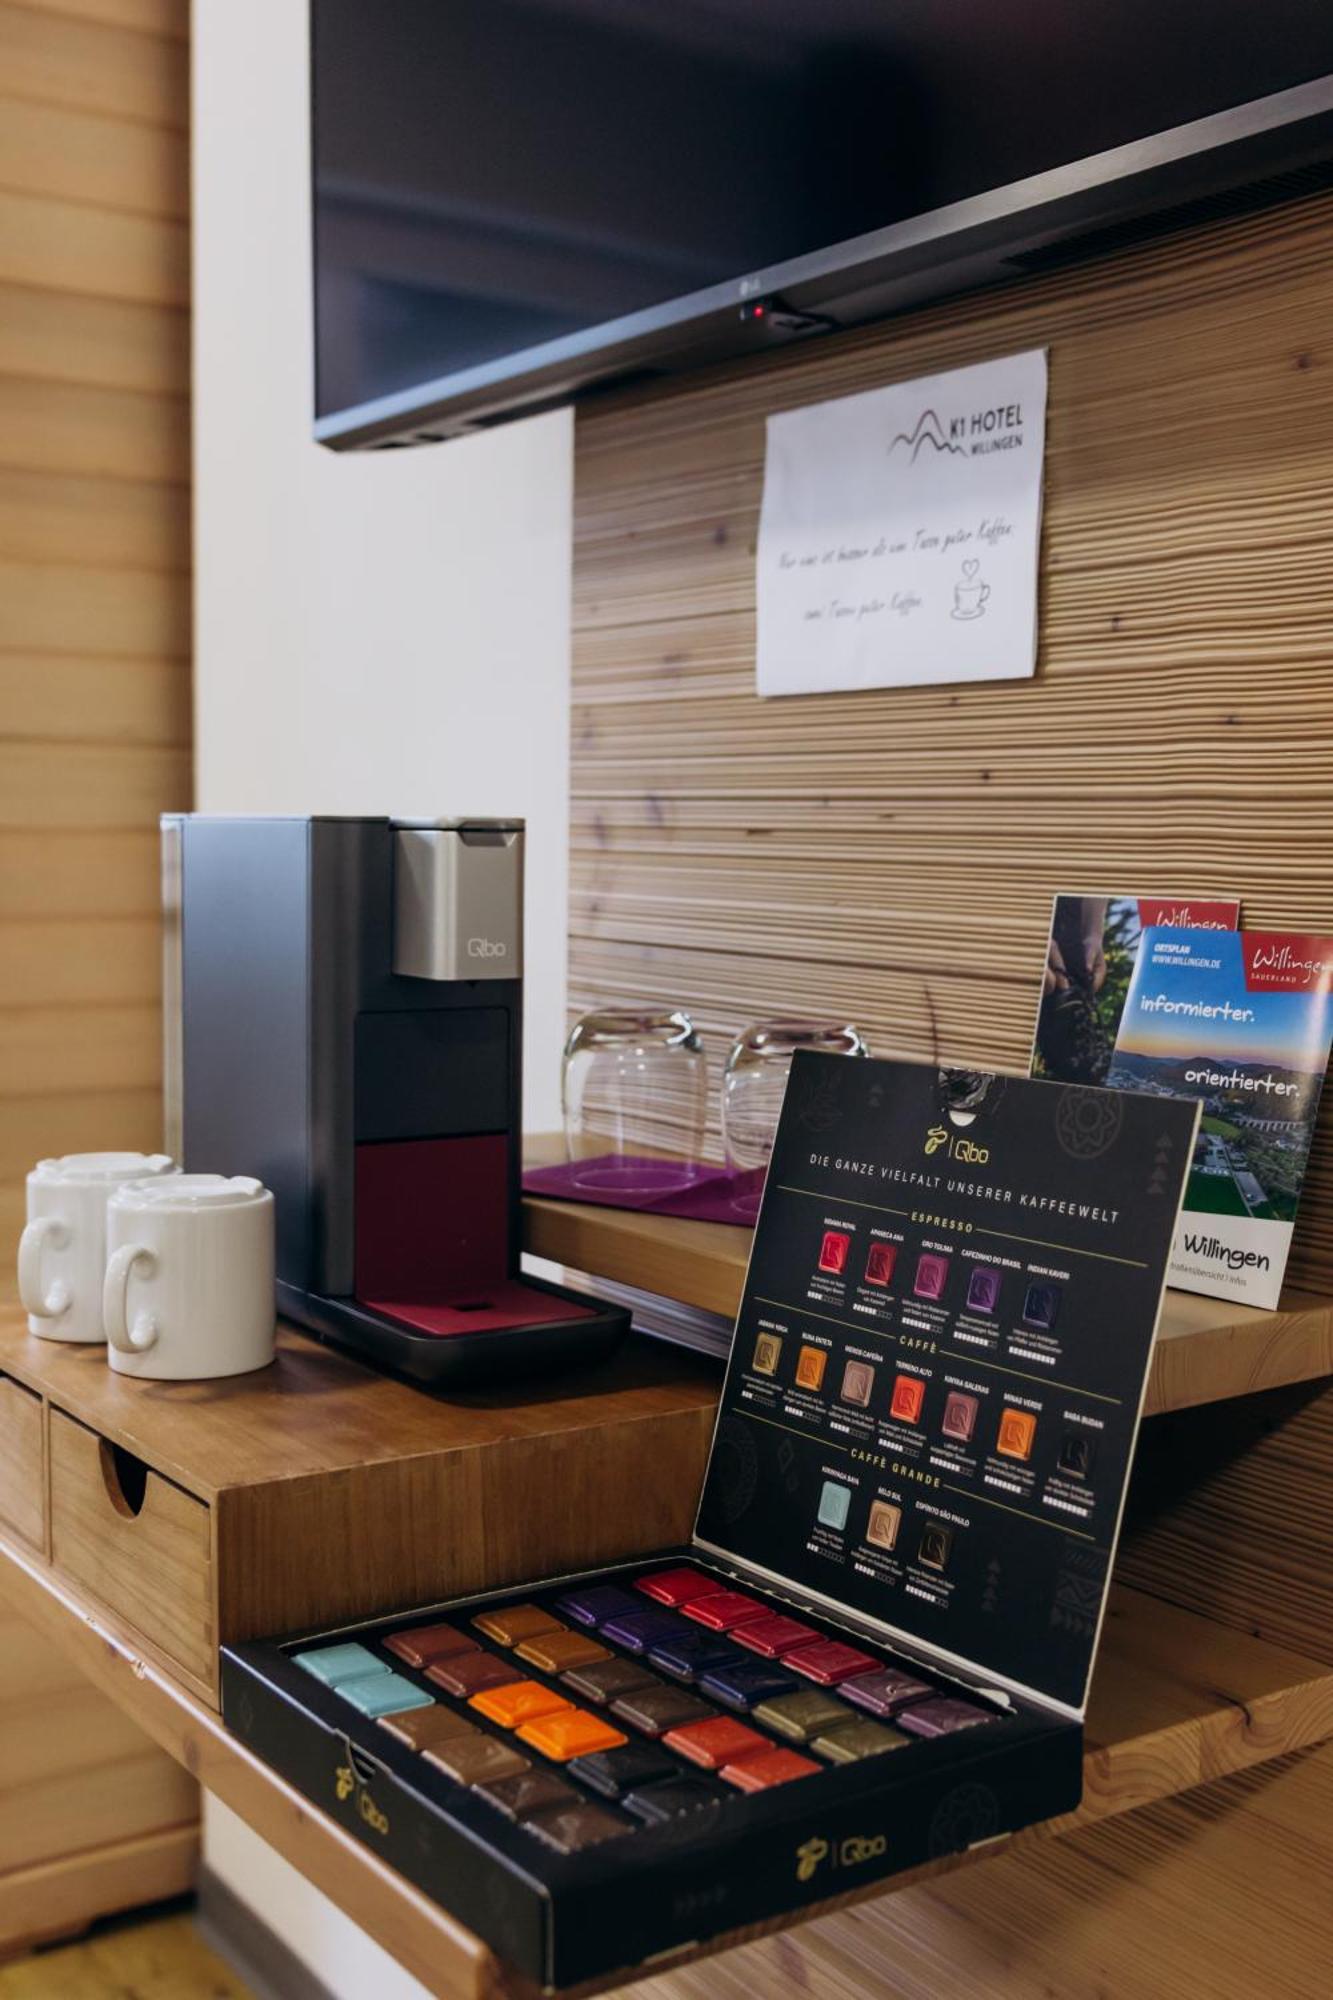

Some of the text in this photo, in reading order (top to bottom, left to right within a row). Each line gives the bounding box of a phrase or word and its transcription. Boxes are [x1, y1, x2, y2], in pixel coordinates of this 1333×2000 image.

[970, 404, 1023, 436] HOTEL
[971, 433, 1023, 455] WILLINGEN
[467, 937, 507, 958] Qbo
[1151, 954, 1222, 969] WWW.WILLINGEN.DE
[1251, 972, 1297, 983] SAUERLAND
[1140, 994, 1256, 1023] informierter.
[1184, 1068, 1301, 1098] orientierter.
[954, 1138, 990, 1165] Qbo
[809, 1153, 1119, 1224] DIE GANZE VIELFALT UNSERER KAFFEEWELT
[911, 1211, 974, 1234] ESPRESSO
[1184, 1233, 1270, 1272] Willingen
[899, 1335, 938, 1354] CAFFÈ
[850, 1447, 942, 1488] CAFFÈ GRANDE
[361, 1790, 389, 1835] Qbo
[840, 1835, 887, 1867] Qbo
